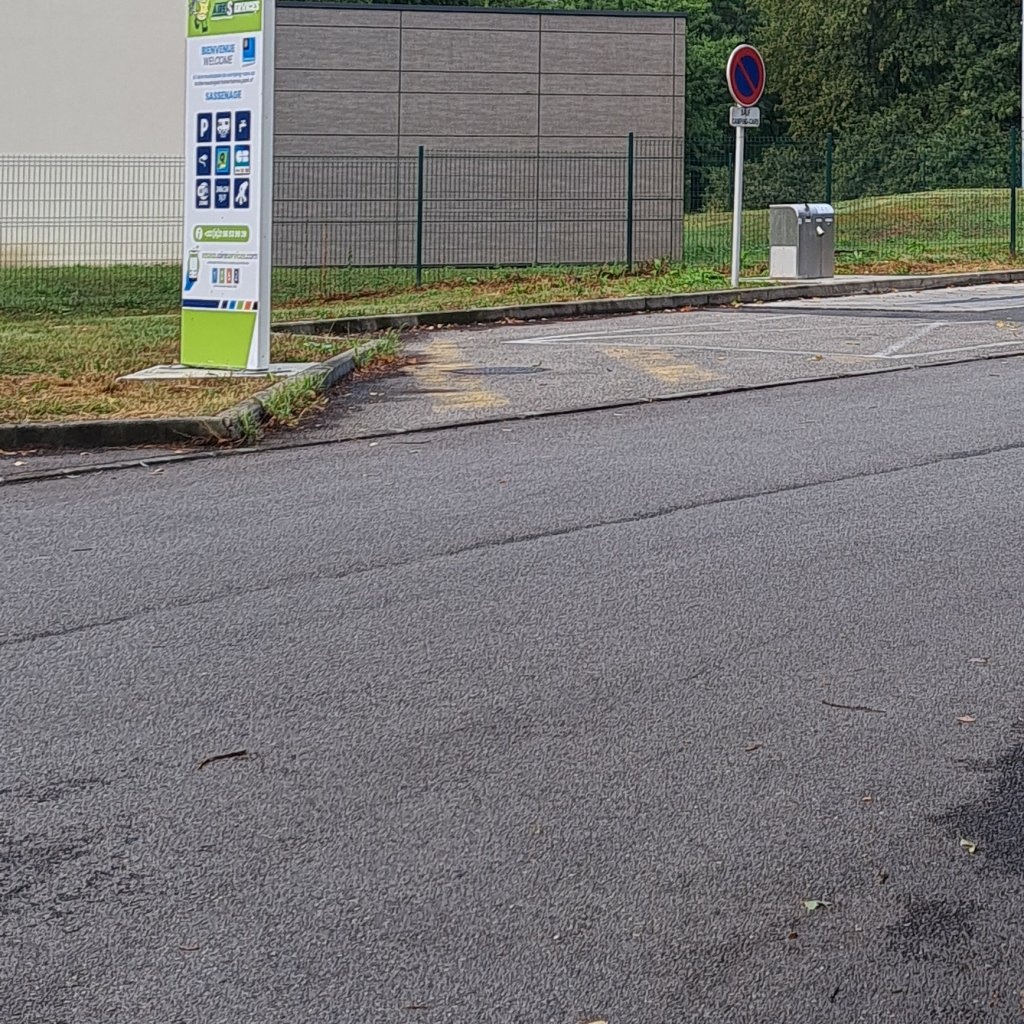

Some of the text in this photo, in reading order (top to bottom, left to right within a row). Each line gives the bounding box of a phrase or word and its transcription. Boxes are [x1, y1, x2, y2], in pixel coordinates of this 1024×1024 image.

[201, 44, 235, 55] BIENVENUE
[203, 55, 233, 66] WELCOME
[205, 90, 242, 101] SASSENAGE
